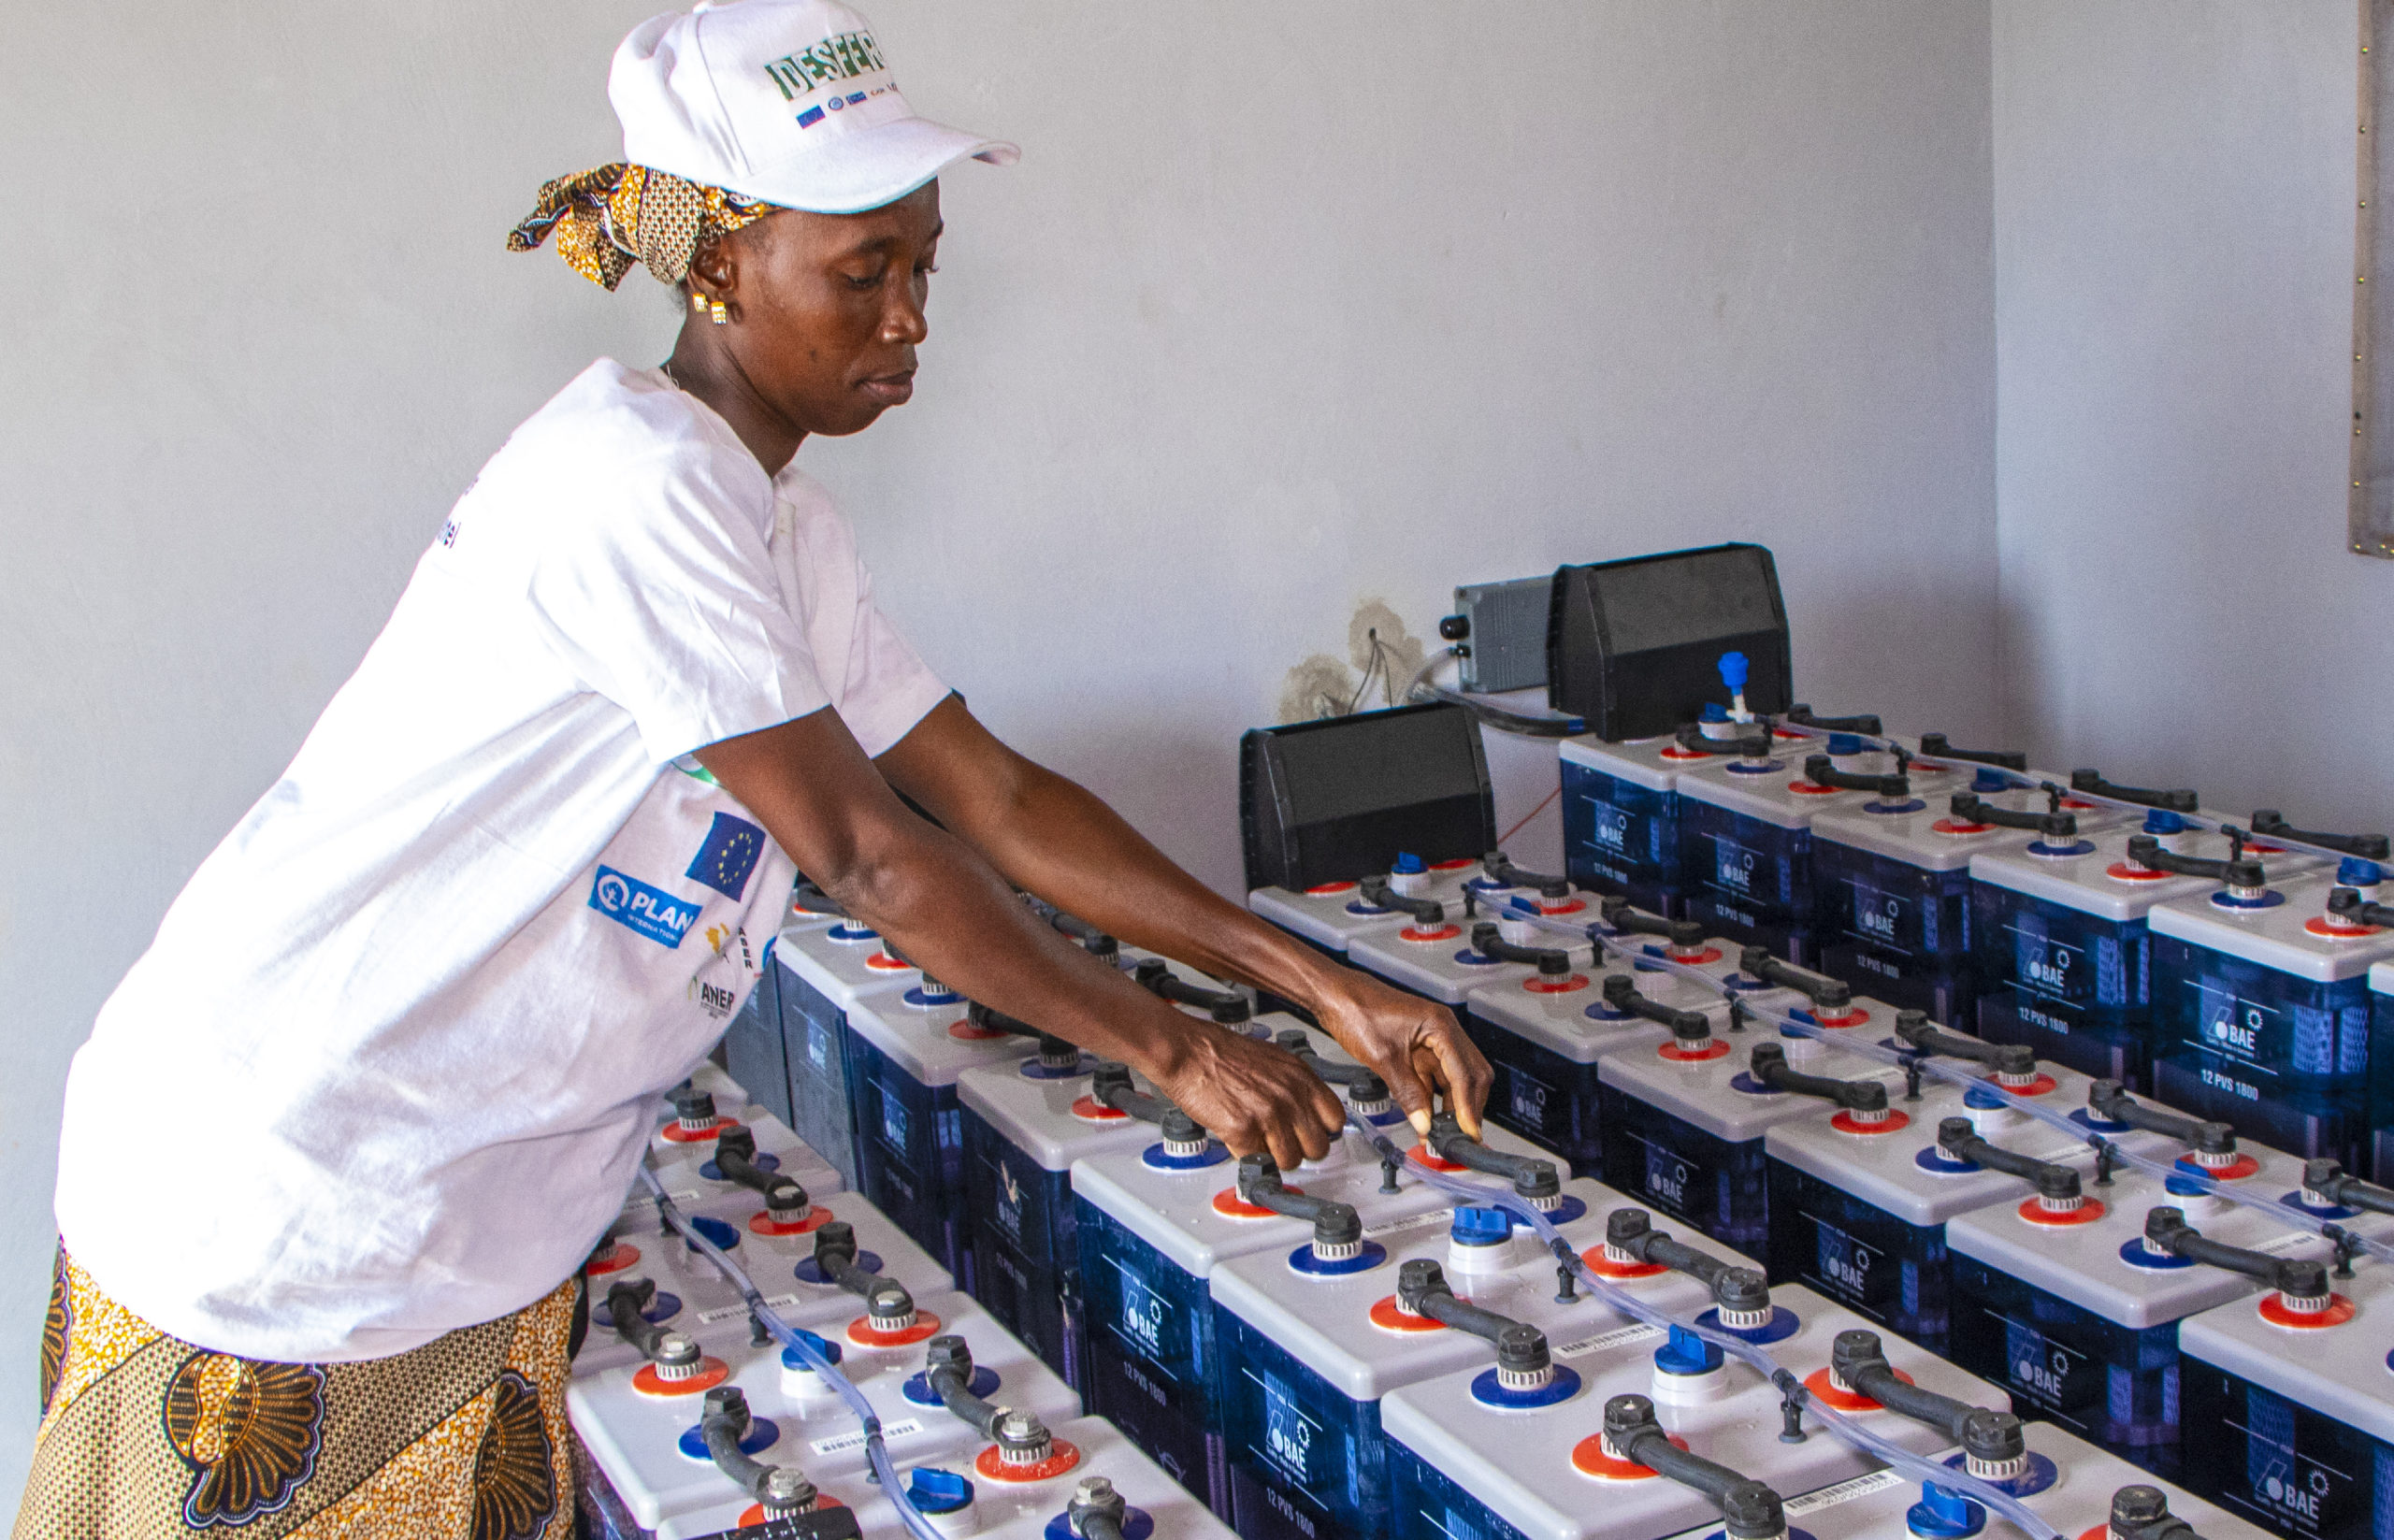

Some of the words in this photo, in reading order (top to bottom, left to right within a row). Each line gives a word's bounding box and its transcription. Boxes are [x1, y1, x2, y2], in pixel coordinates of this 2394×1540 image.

[1732, 867, 1750, 886] BAE
[630, 892, 695, 933] PLAN
[1875, 914, 1895, 936] BAE
[2041, 964, 2065, 988] BAE
[701, 982, 735, 1012] ANER
[2019, 1007, 2030, 1022] 12
[2030, 1010, 2048, 1027] PVS
[2049, 1016, 2070, 1035] 1800
[2228, 1024, 2256, 1051] BAE
[2200, 1069, 2214, 1085] 12
[2214, 1072, 2234, 1092] PVS
[2235, 1081, 2259, 1101] 1800
[1663, 1177, 1682, 1203] BAE
[1840, 1260, 1865, 1291] BAE
[1138, 1314, 1159, 1347] BAE
[2034, 1365, 2062, 1399] BAE
[1283, 1434, 1306, 1474] BAE
[1266, 1487, 1276, 1507] 12
[1277, 1495, 1294, 1522] PVS
[1295, 1509, 1315, 1539] 1800
[2286, 1483, 2320, 1520] BAE
